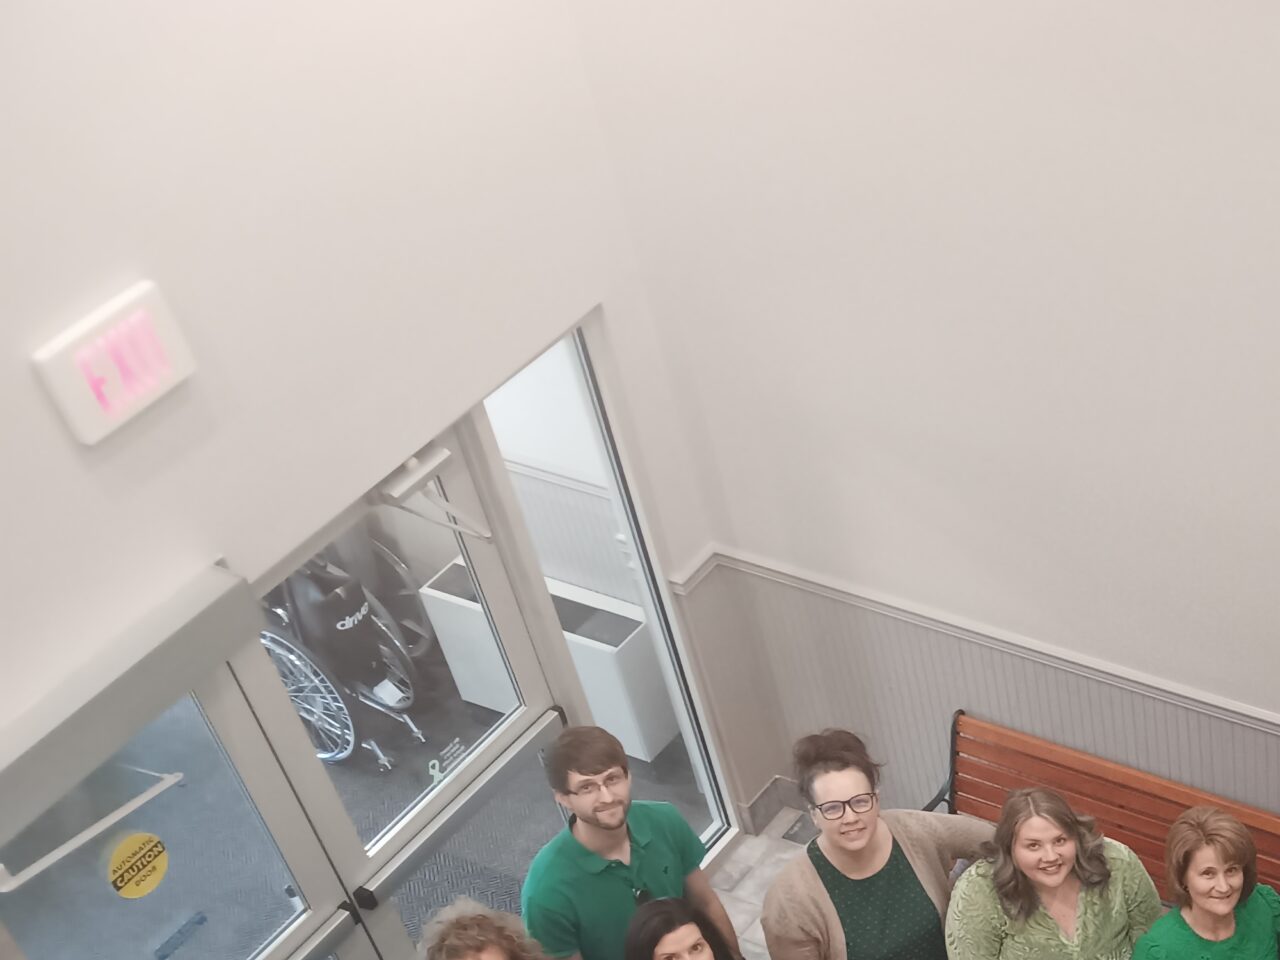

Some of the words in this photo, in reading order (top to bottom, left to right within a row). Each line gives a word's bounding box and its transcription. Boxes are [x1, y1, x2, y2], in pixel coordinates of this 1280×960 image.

[112, 837, 154, 876] AUTOMATIC
[116, 843, 164, 887] CAUTION
[135, 865, 157, 887] DOOR
